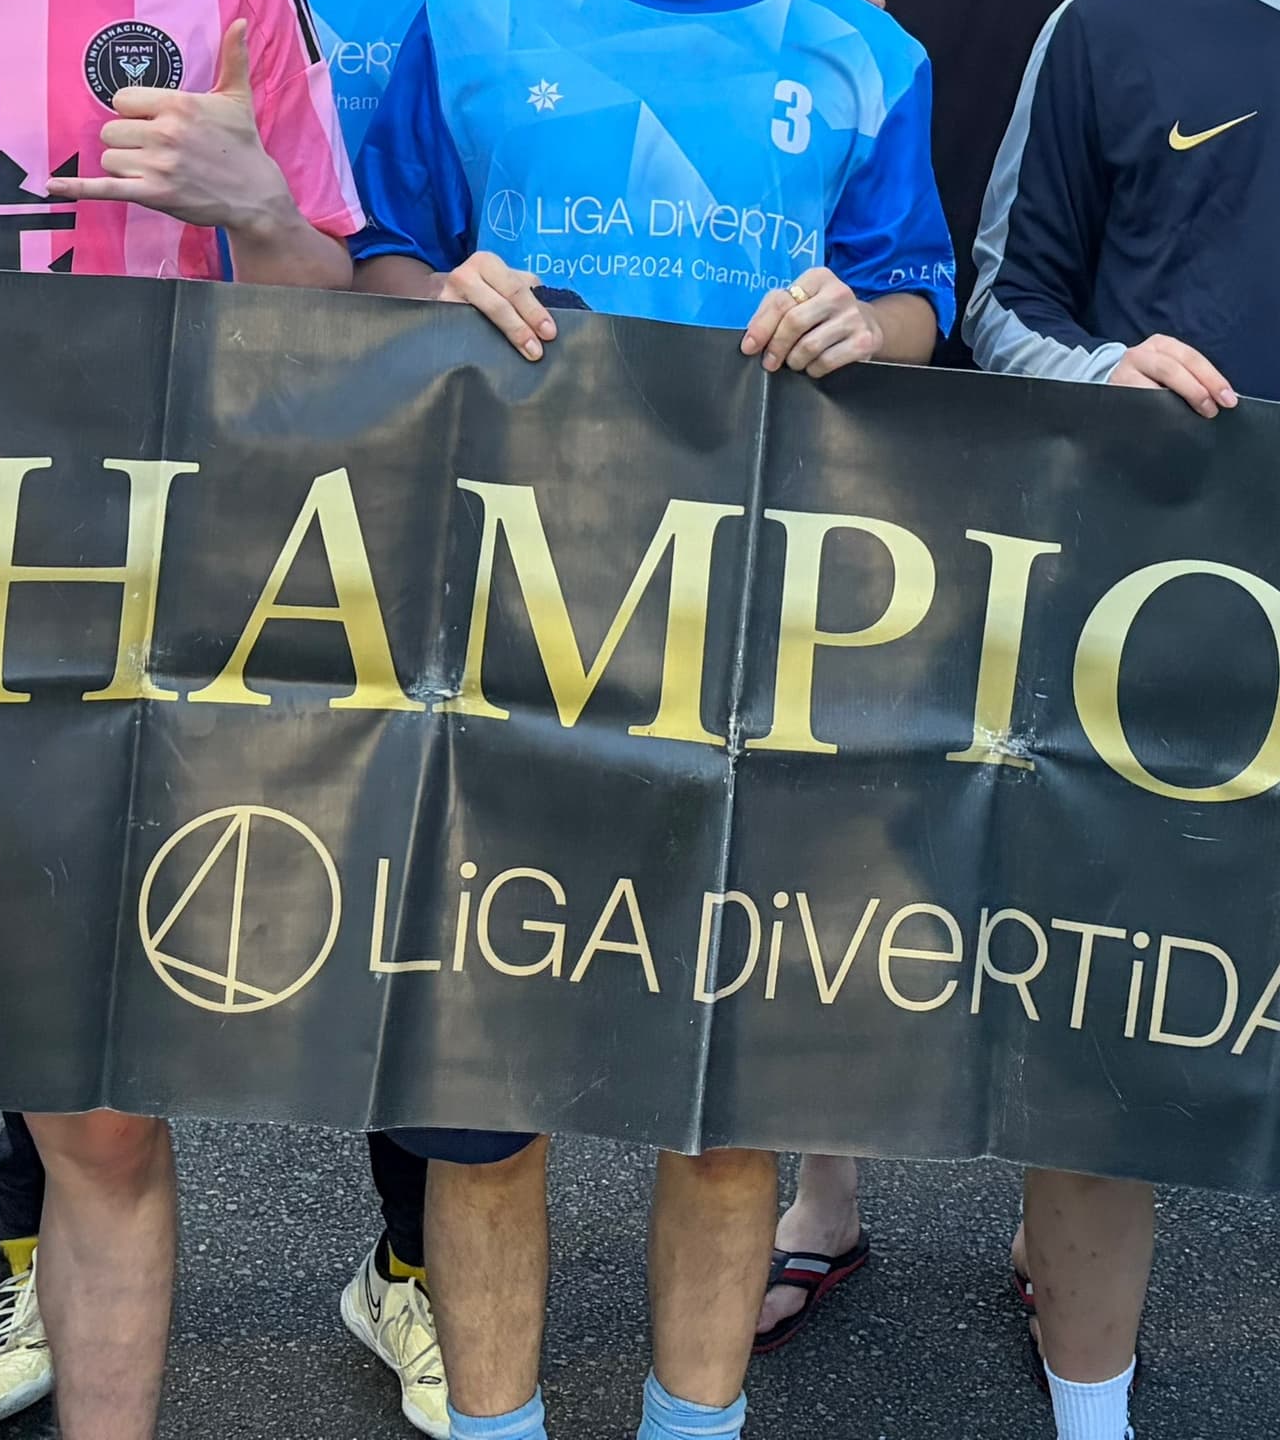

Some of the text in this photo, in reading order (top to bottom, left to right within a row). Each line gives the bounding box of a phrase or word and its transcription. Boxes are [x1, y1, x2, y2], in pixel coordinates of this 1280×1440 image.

[87, 24, 183, 93] CLUB INTERNACIONAL DE FÚTBO
[115, 45, 154, 54] MIAMI
[771, 79, 812, 156] 3
